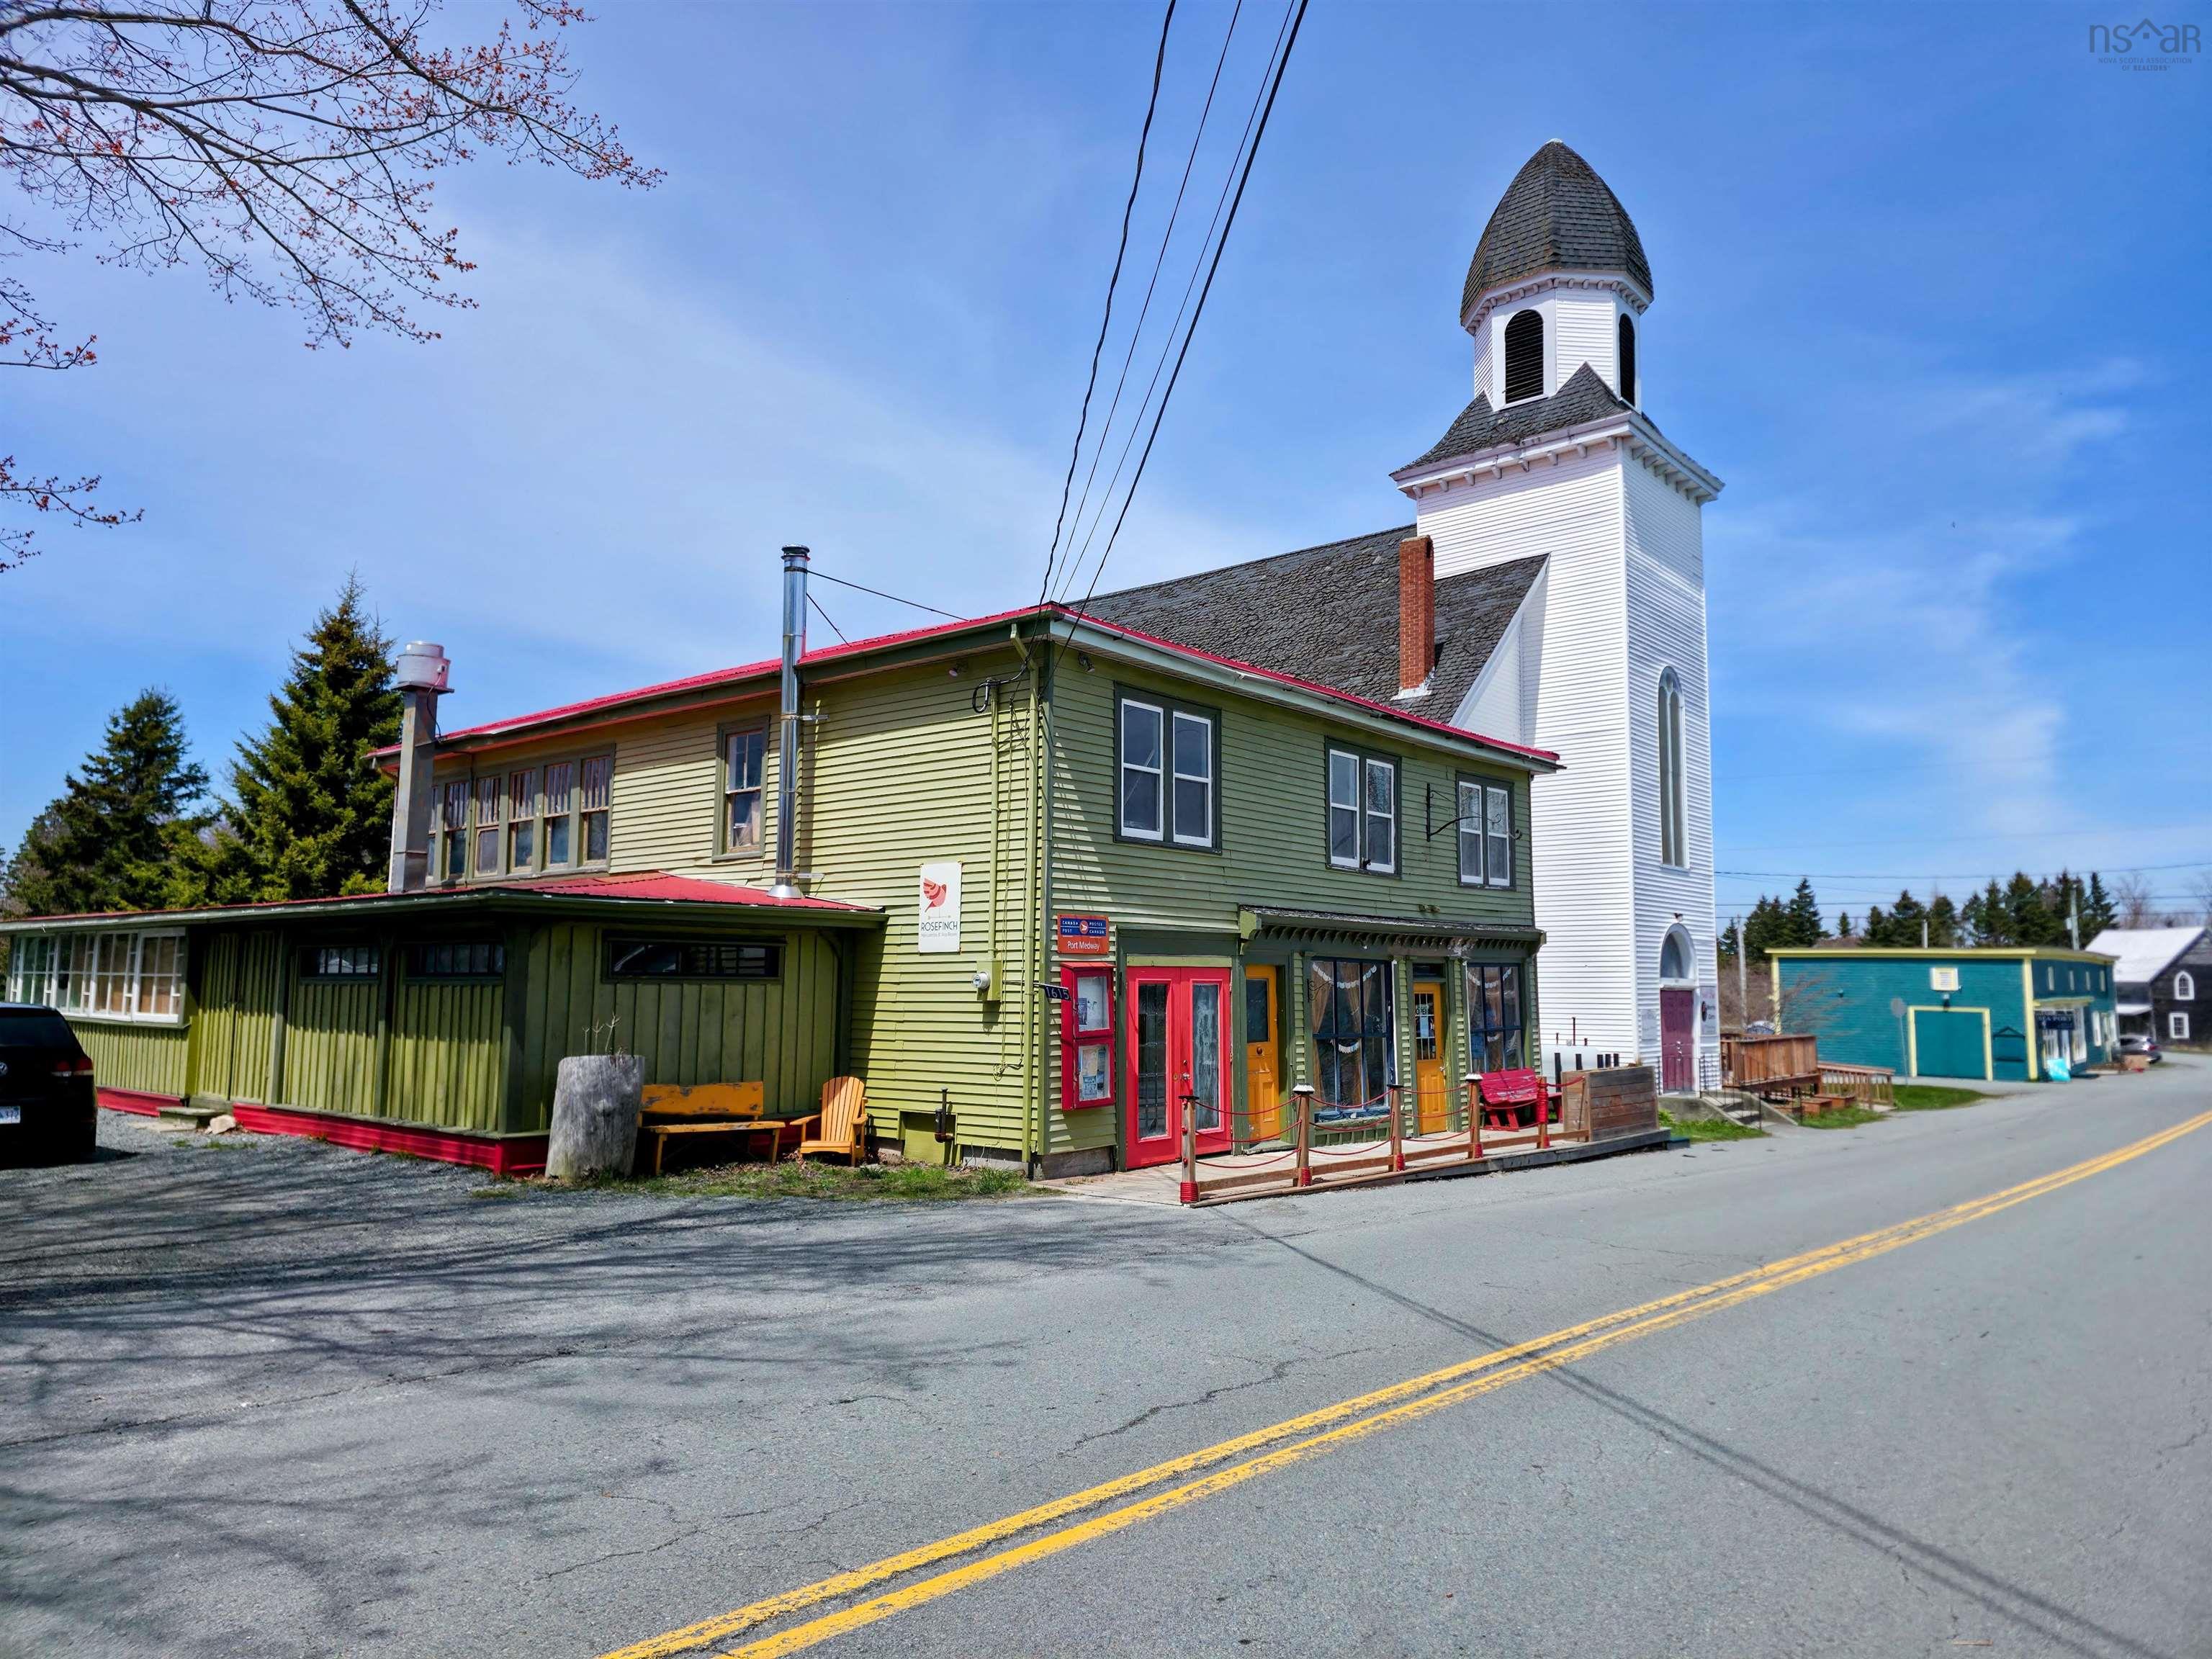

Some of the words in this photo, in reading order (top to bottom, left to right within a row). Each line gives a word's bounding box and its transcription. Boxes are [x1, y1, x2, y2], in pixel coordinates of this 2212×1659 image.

[920, 921, 958, 932] ROSEFINCH
[1067, 940, 1078, 949] Port
[1079, 941, 1100, 951] Medway
[1046, 986, 1070, 1000] 1615
